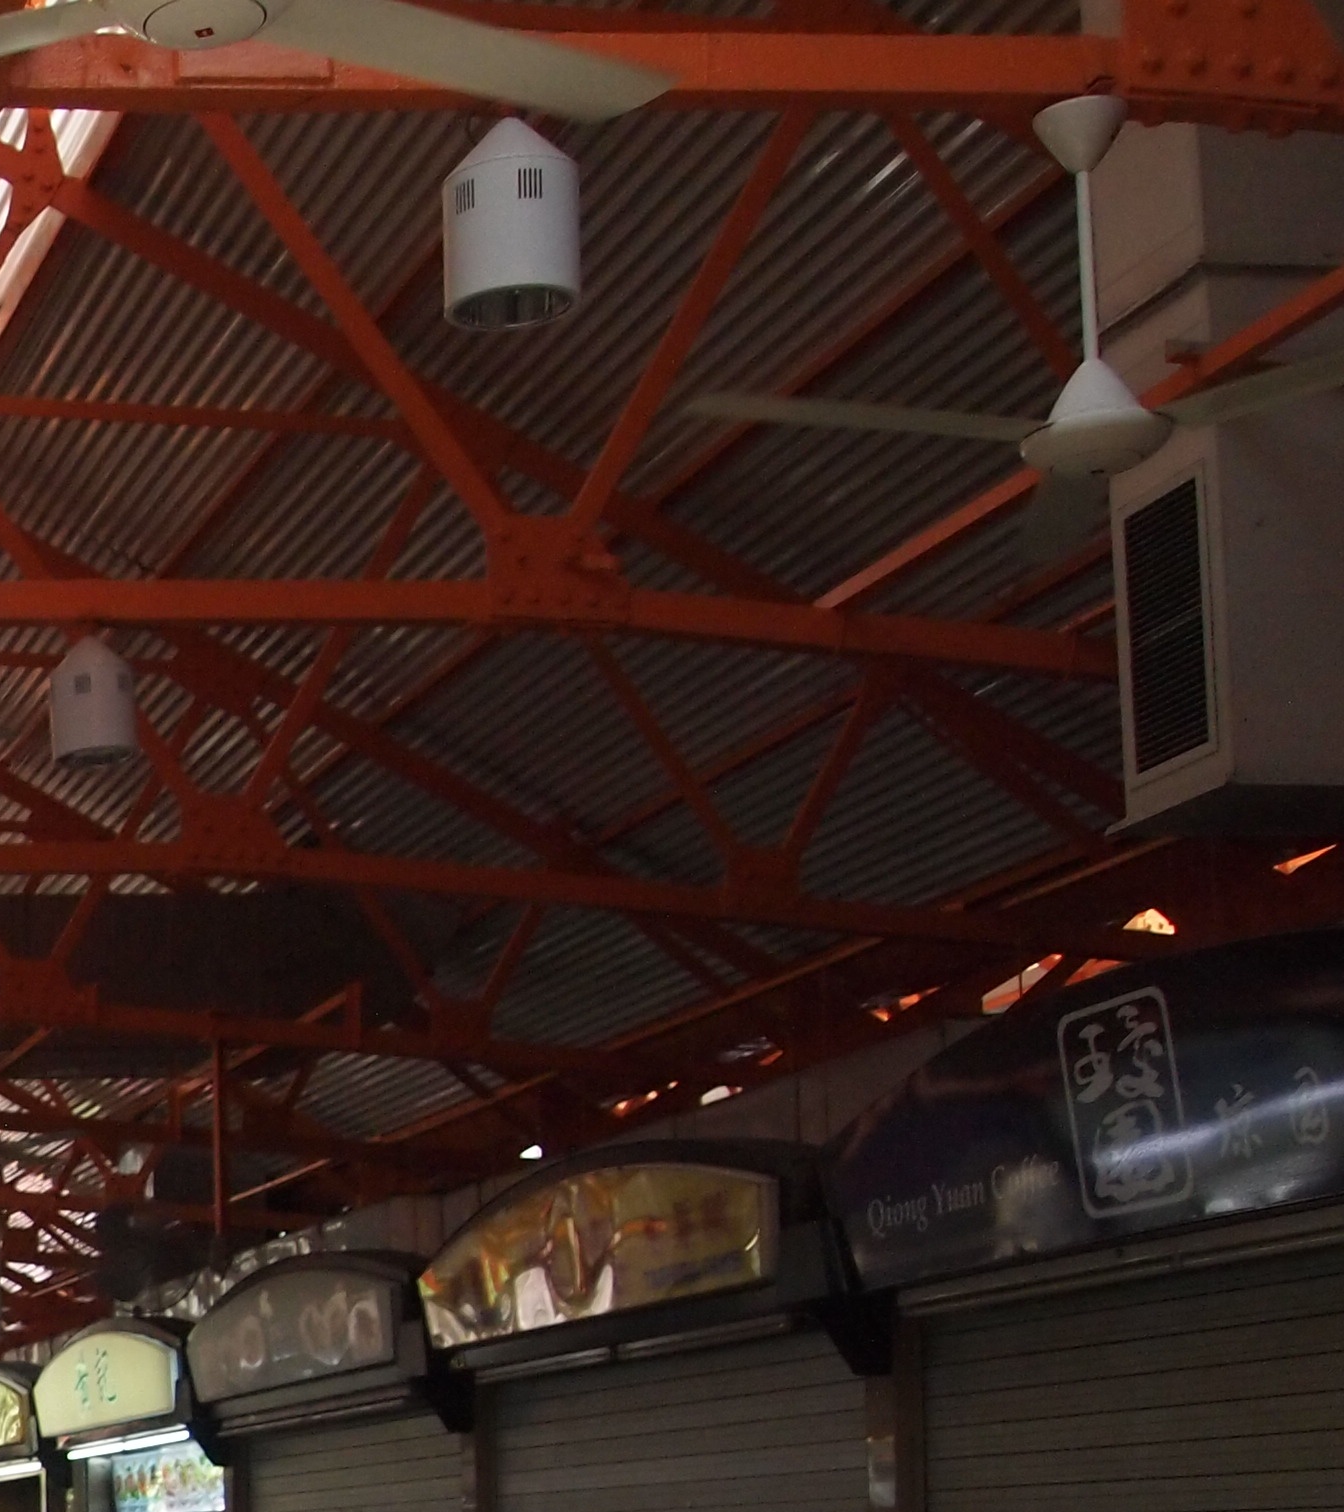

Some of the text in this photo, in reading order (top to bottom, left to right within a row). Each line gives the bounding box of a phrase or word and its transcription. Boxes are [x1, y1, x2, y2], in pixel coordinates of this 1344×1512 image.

[867, 1153, 1060, 1239] Qiong Yuan Coffee
